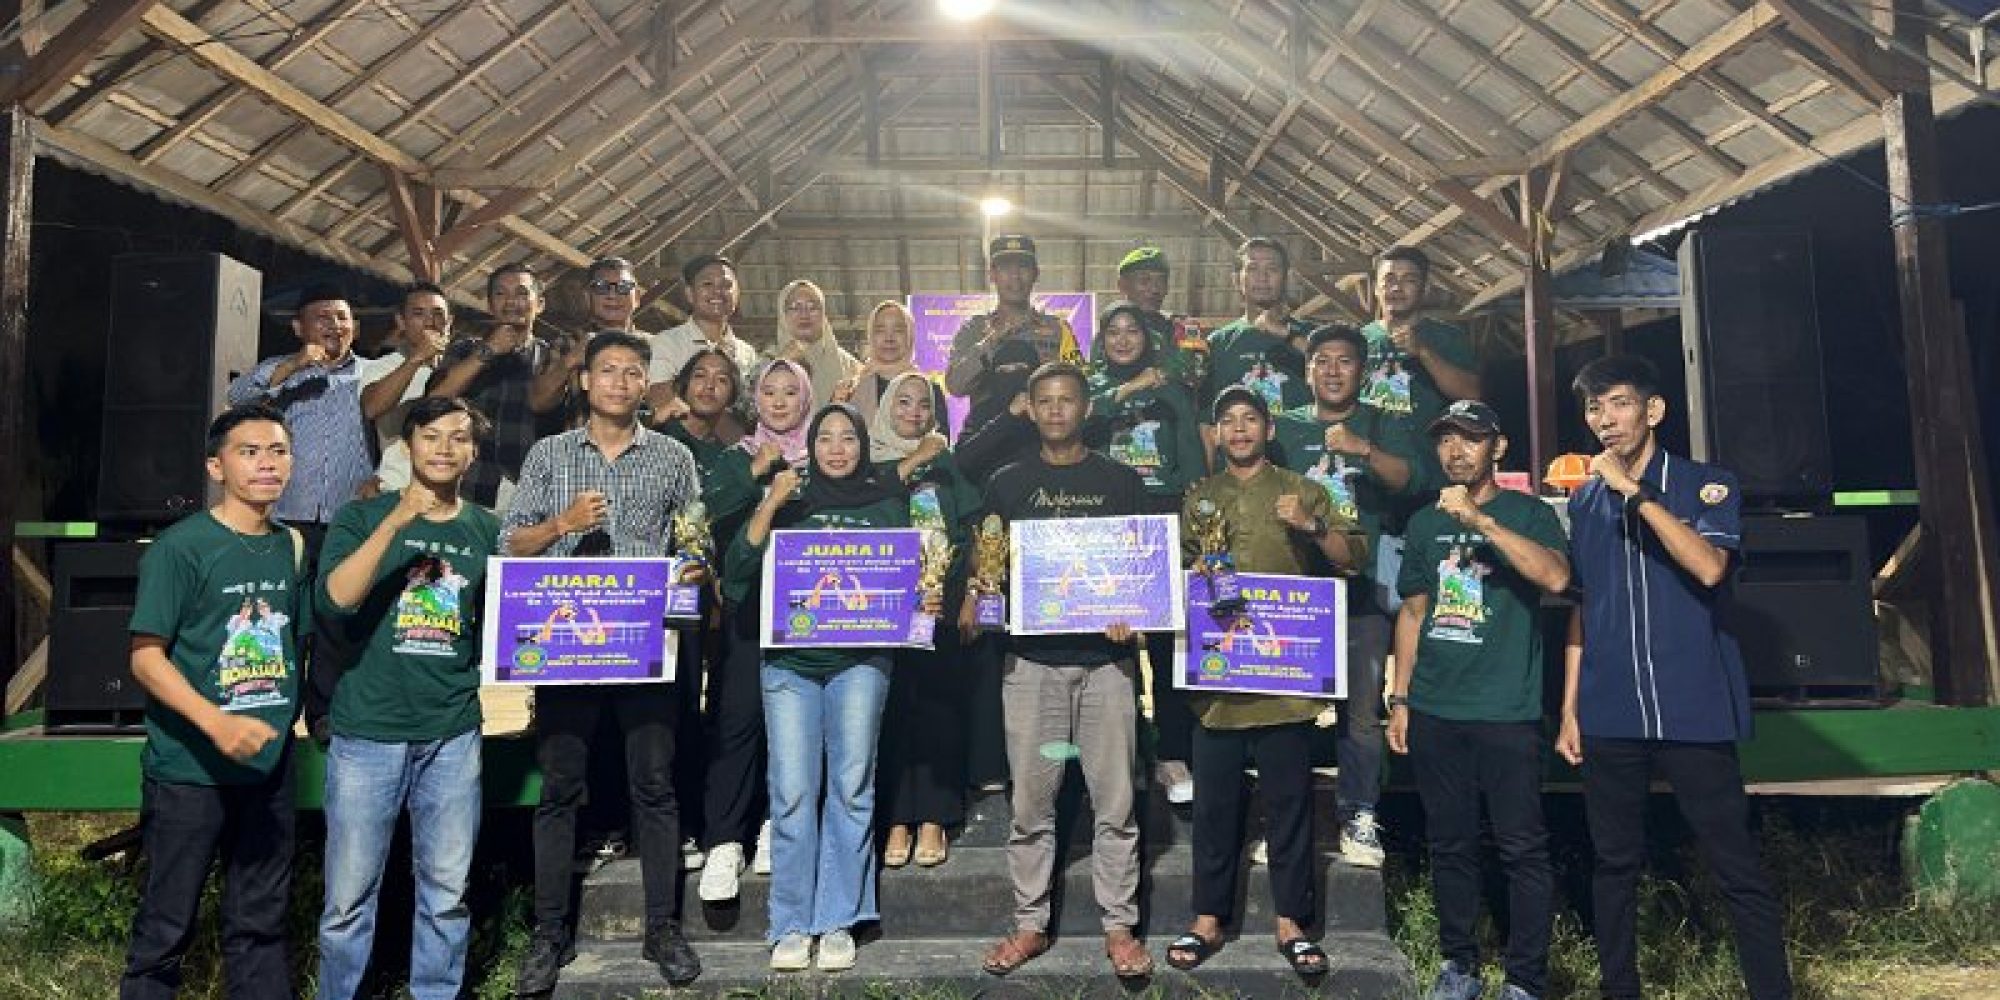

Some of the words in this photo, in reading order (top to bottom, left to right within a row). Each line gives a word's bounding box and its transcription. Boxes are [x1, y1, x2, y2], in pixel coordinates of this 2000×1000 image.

[802, 544, 873, 556] JUARA
[879, 544, 894, 556] II
[535, 574, 619, 588] JUARA
[625, 574, 636, 588] I
[1287, 590, 1311, 603] IV
